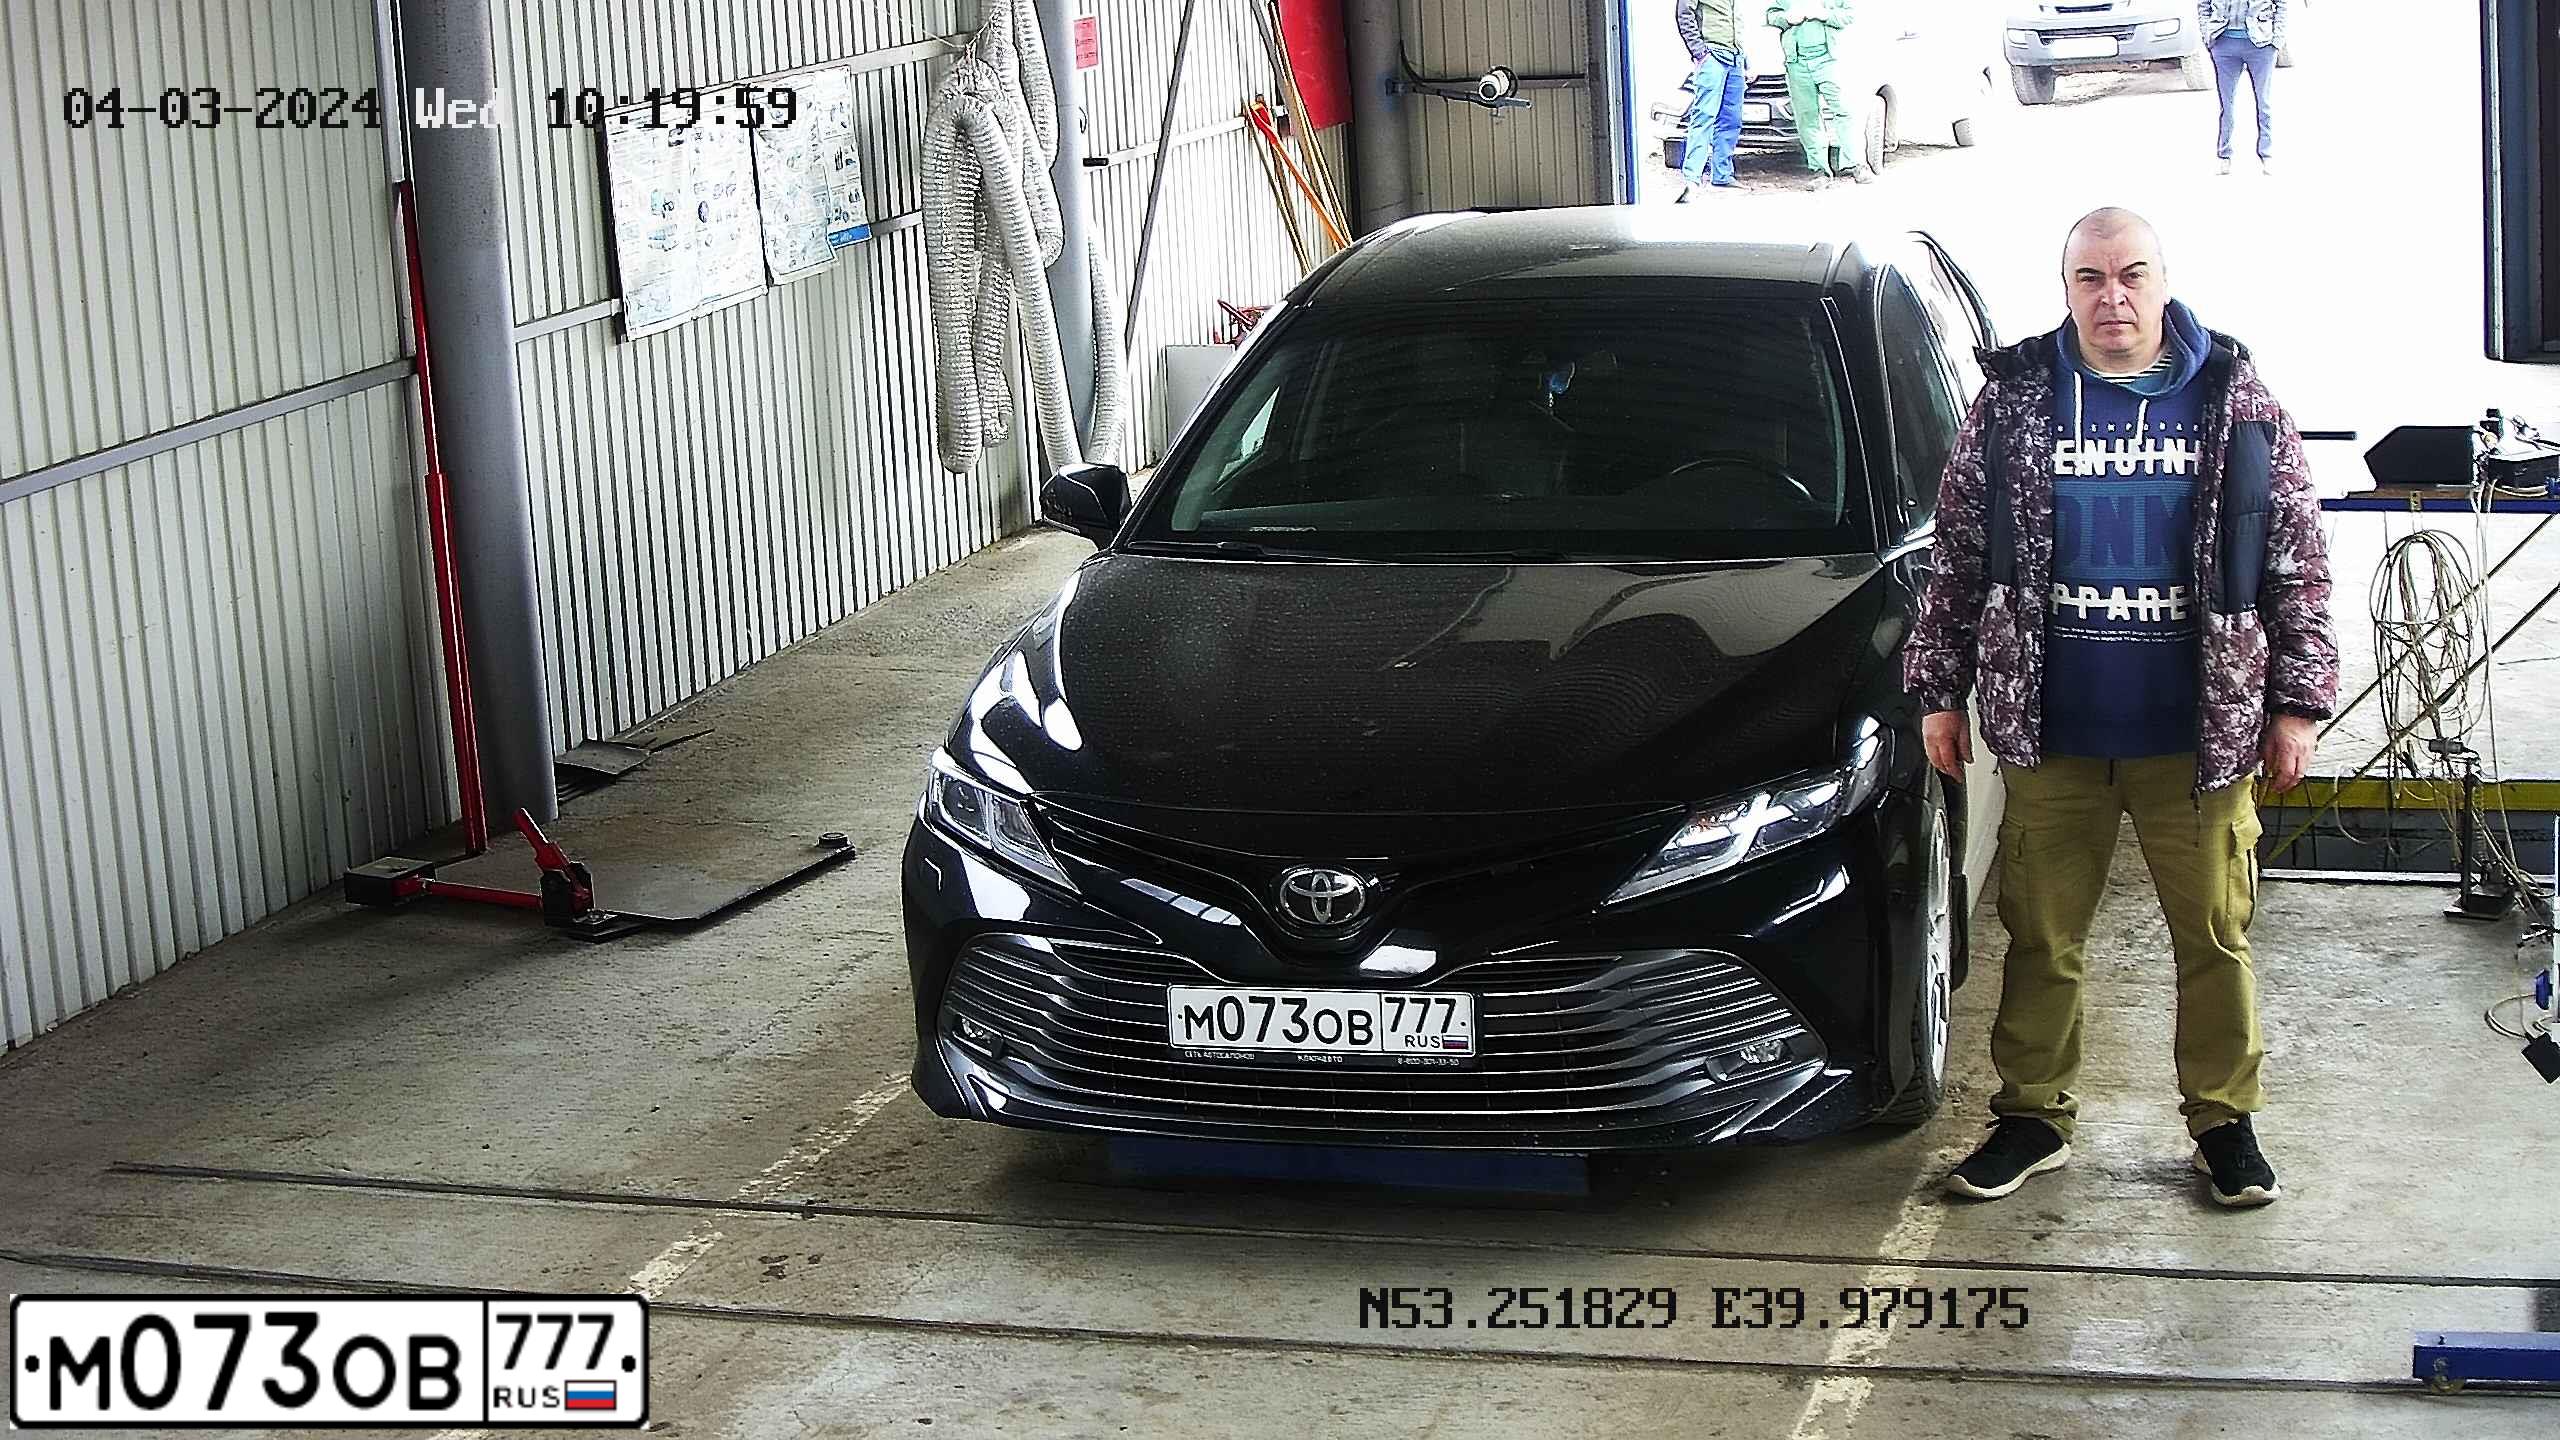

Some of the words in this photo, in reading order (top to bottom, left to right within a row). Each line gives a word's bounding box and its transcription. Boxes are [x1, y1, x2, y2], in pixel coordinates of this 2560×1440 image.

[1184, 995, 1375, 1046] М073ОВ
[1384, 996, 1458, 1034] 777
[1404, 1035, 1441, 1049] RUS
